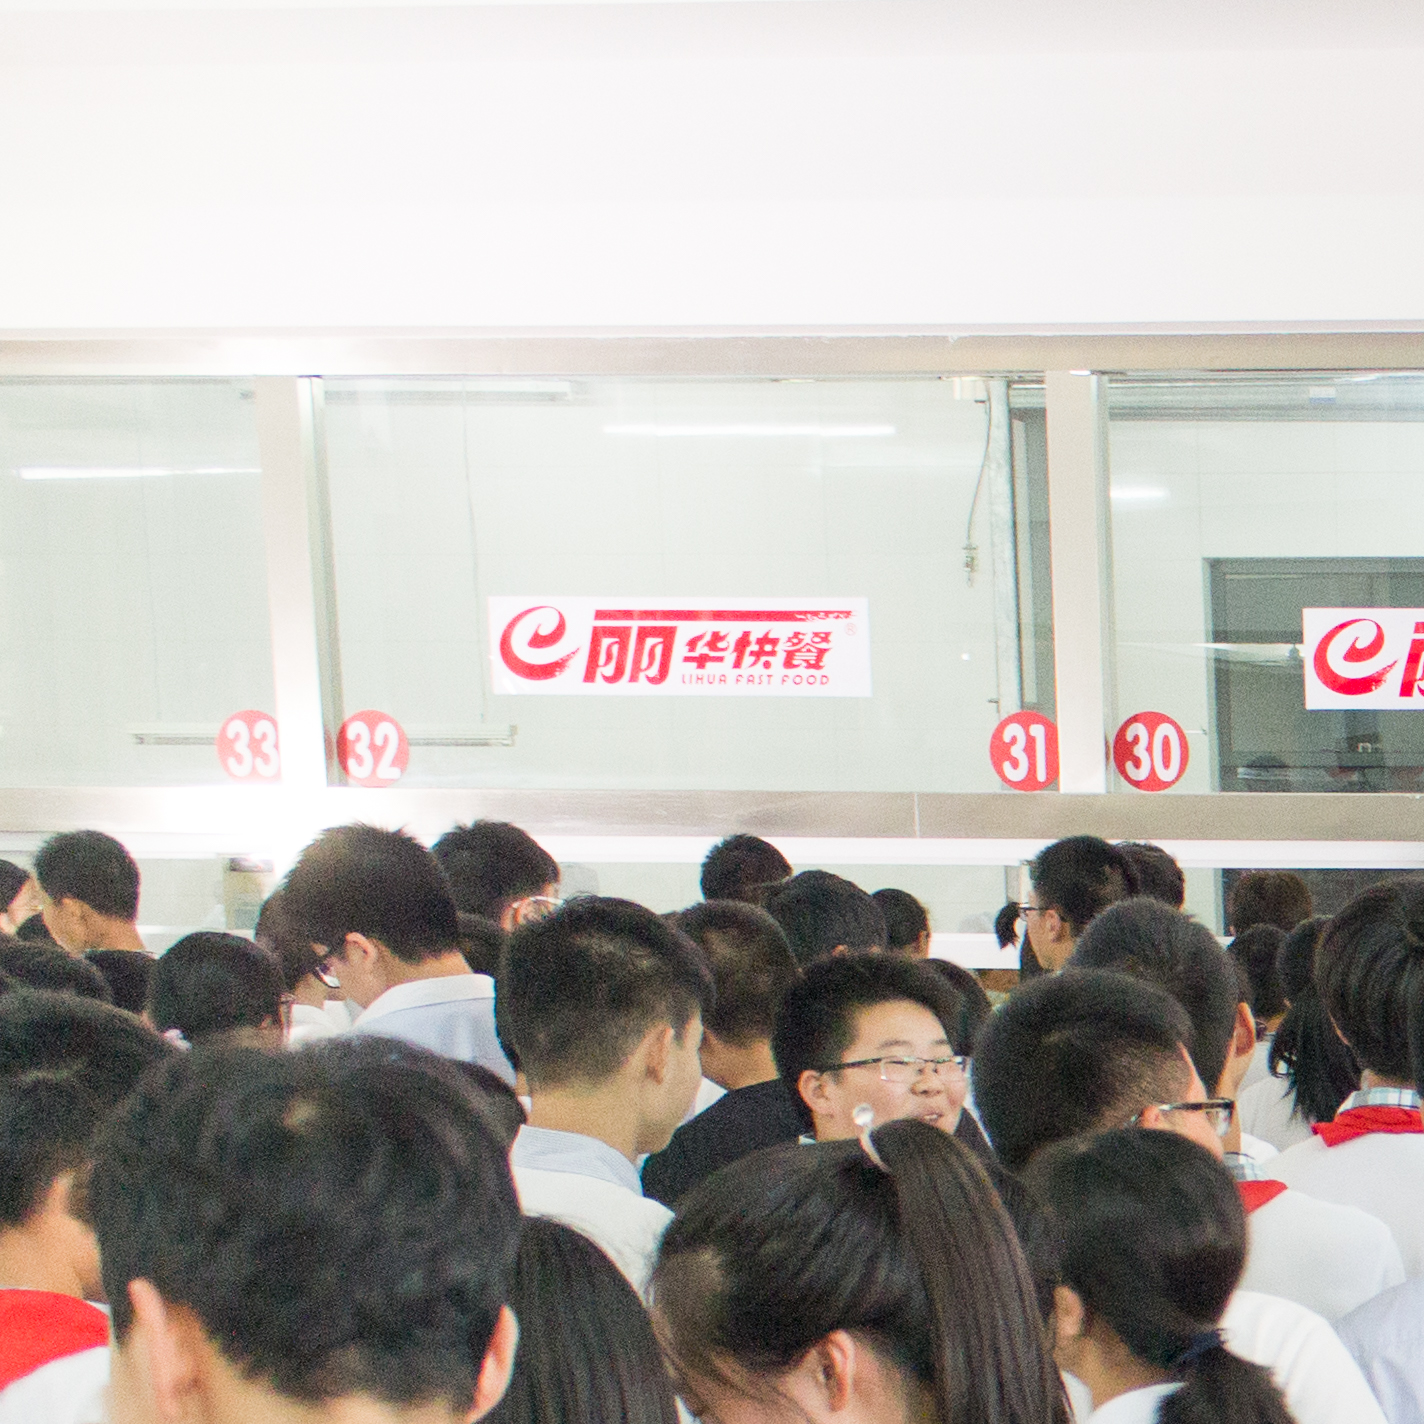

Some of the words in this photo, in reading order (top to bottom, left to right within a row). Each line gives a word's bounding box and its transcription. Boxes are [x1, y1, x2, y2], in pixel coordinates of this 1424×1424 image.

[227, 719, 279, 777] 33
[347, 720, 401, 779] 32
[1003, 722, 1046, 782] 31
[1125, 722, 1181, 782] 30
